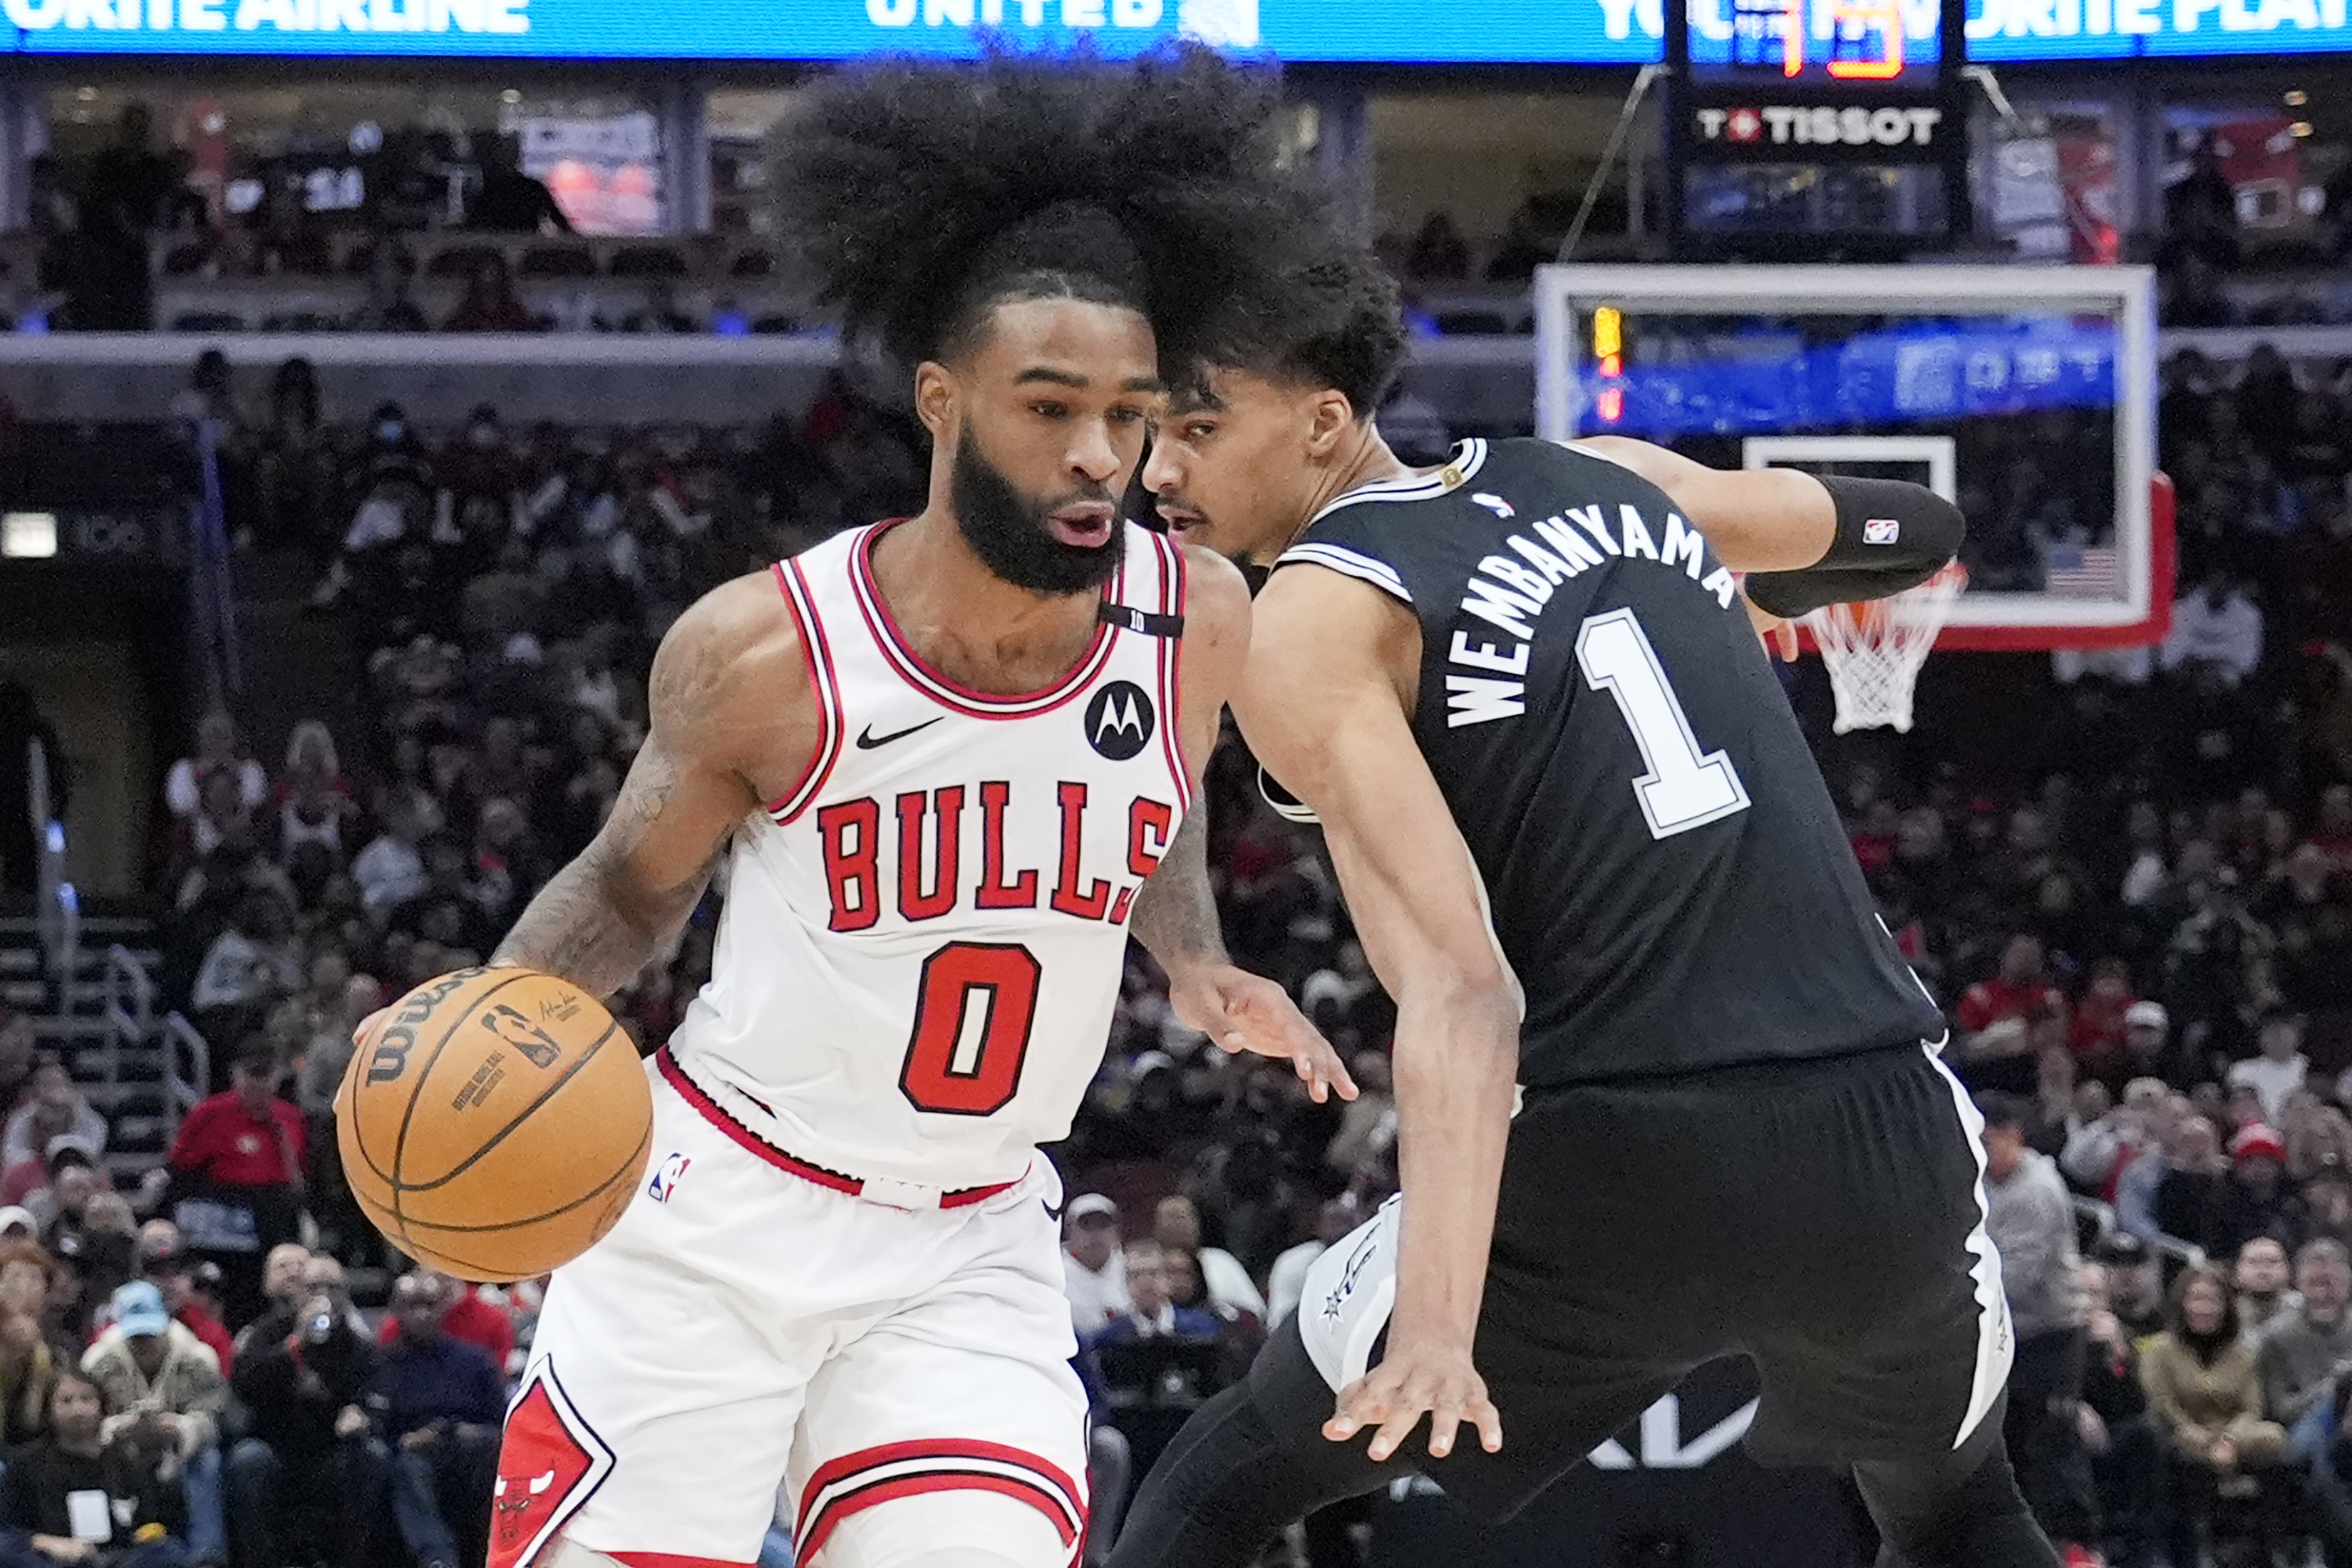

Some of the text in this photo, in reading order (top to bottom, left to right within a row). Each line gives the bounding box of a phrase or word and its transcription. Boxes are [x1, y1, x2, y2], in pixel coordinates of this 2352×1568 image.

[235, 0, 530, 33] AIRLINE
[866, 0, 1164, 27] UNITED
[1761, 106, 1943, 145] TISSOT
[1130, 609, 1145, 633] 10
[1445, 503, 1735, 728] WEMBANYAMA
[1574, 606, 1753, 840] 1
[817, 780, 1172, 933] BULLS
[898, 940, 1043, 1116] 0
